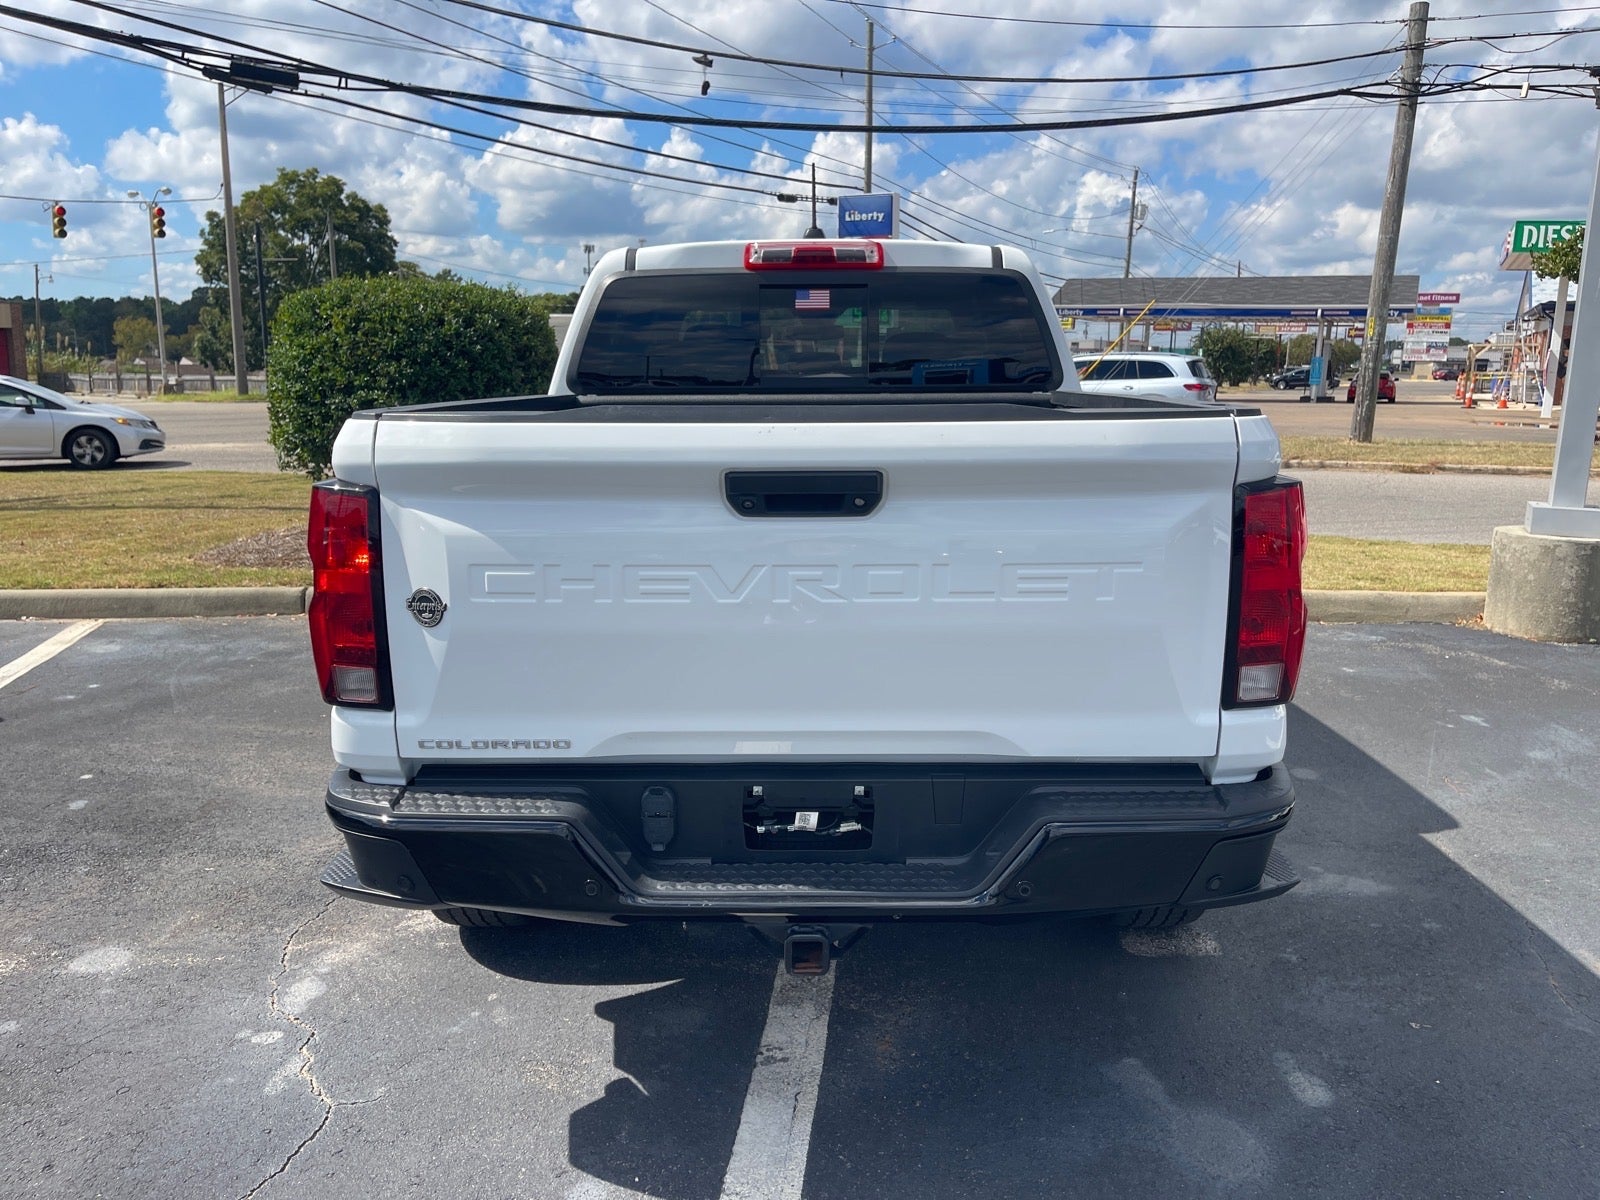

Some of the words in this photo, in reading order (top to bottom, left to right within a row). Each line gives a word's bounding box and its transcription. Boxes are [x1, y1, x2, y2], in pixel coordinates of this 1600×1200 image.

[845, 210, 885, 222] Liberty
[1058, 308, 1084, 316] Liberty
[468, 561, 1144, 603] CHEVROLET
[406, 598, 447, 613] Enterprise
[418, 739, 571, 750] COLORADO
